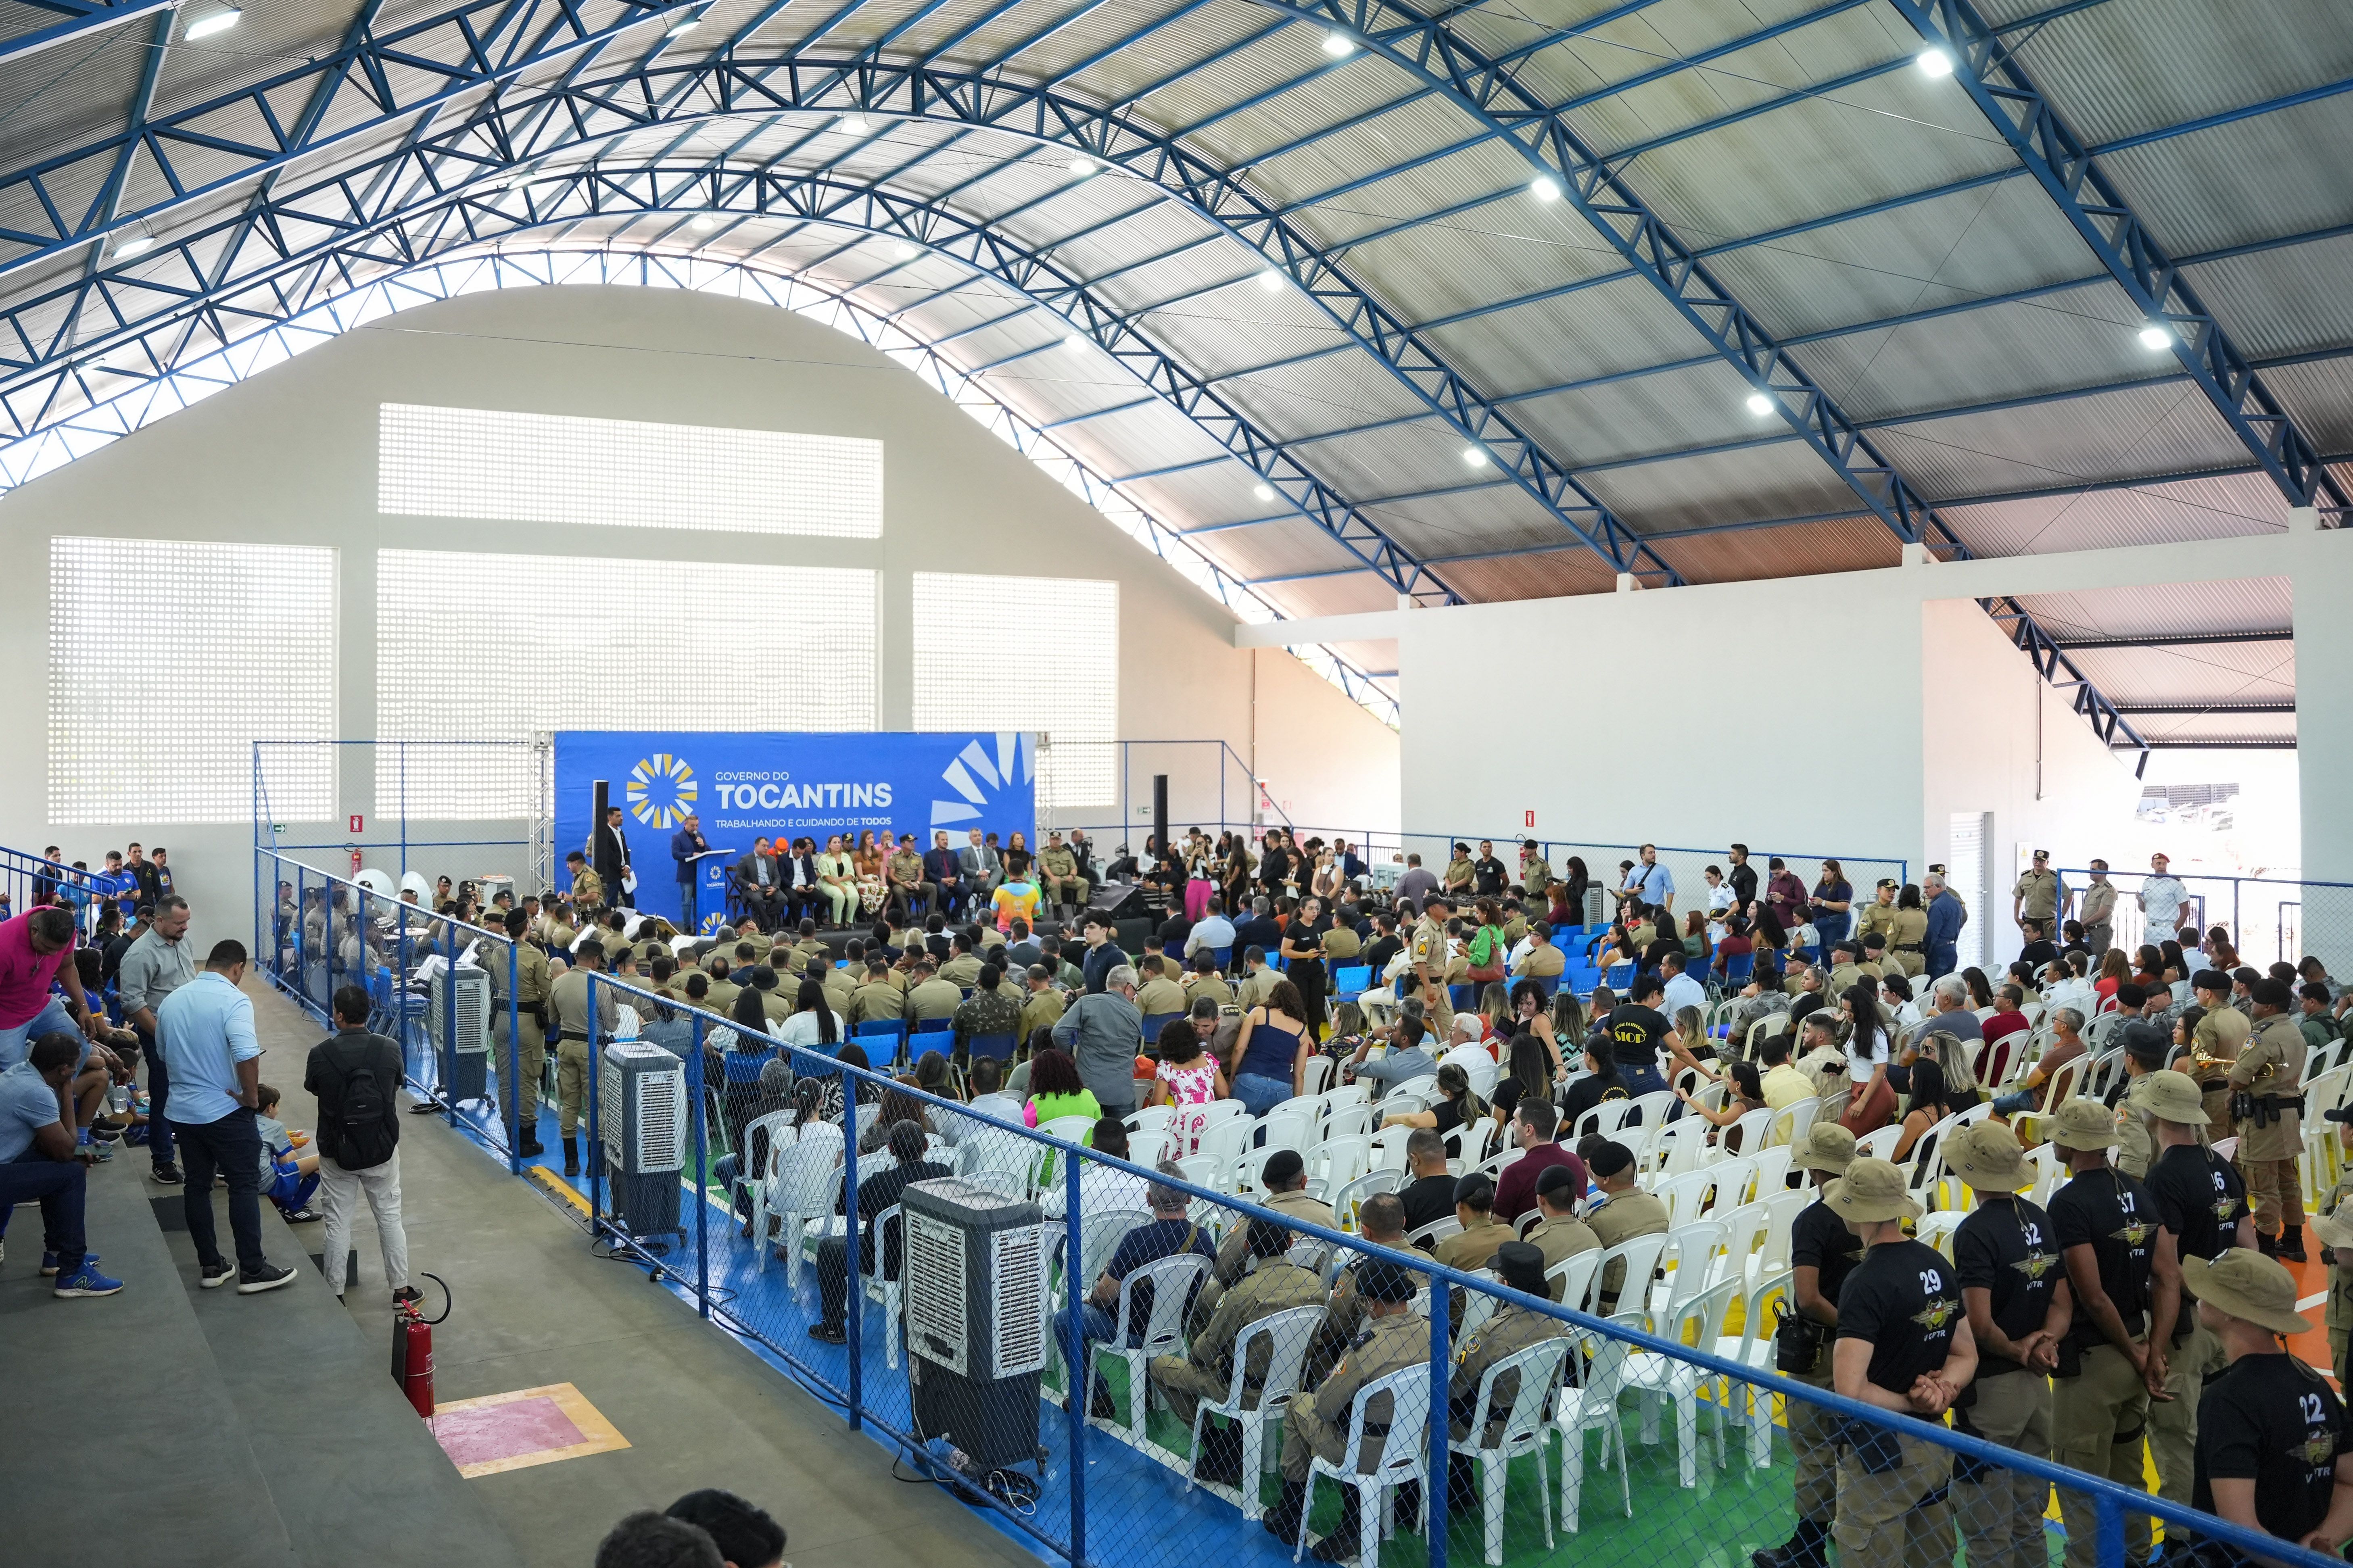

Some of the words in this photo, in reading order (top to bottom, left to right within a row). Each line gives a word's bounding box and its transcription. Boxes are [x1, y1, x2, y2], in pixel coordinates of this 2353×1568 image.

[715, 771, 770, 781] GOVERNO
[773, 771, 789, 780] DO
[715, 782, 892, 809] TOCANTINS
[715, 819, 786, 828] TRABALHANDO
[795, 818, 845, 827] CUIDANDO
[846, 817, 859, 826] DE
[860, 817, 892, 825] TODOS
[1615, 1031, 1645, 1043] SIOP
[2117, 1192, 2135, 1213] 37
[2219, 1222, 2234, 1230] CPTR
[1919, 1269, 1942, 1295] 29
[2299, 1393, 2326, 1424] 22
